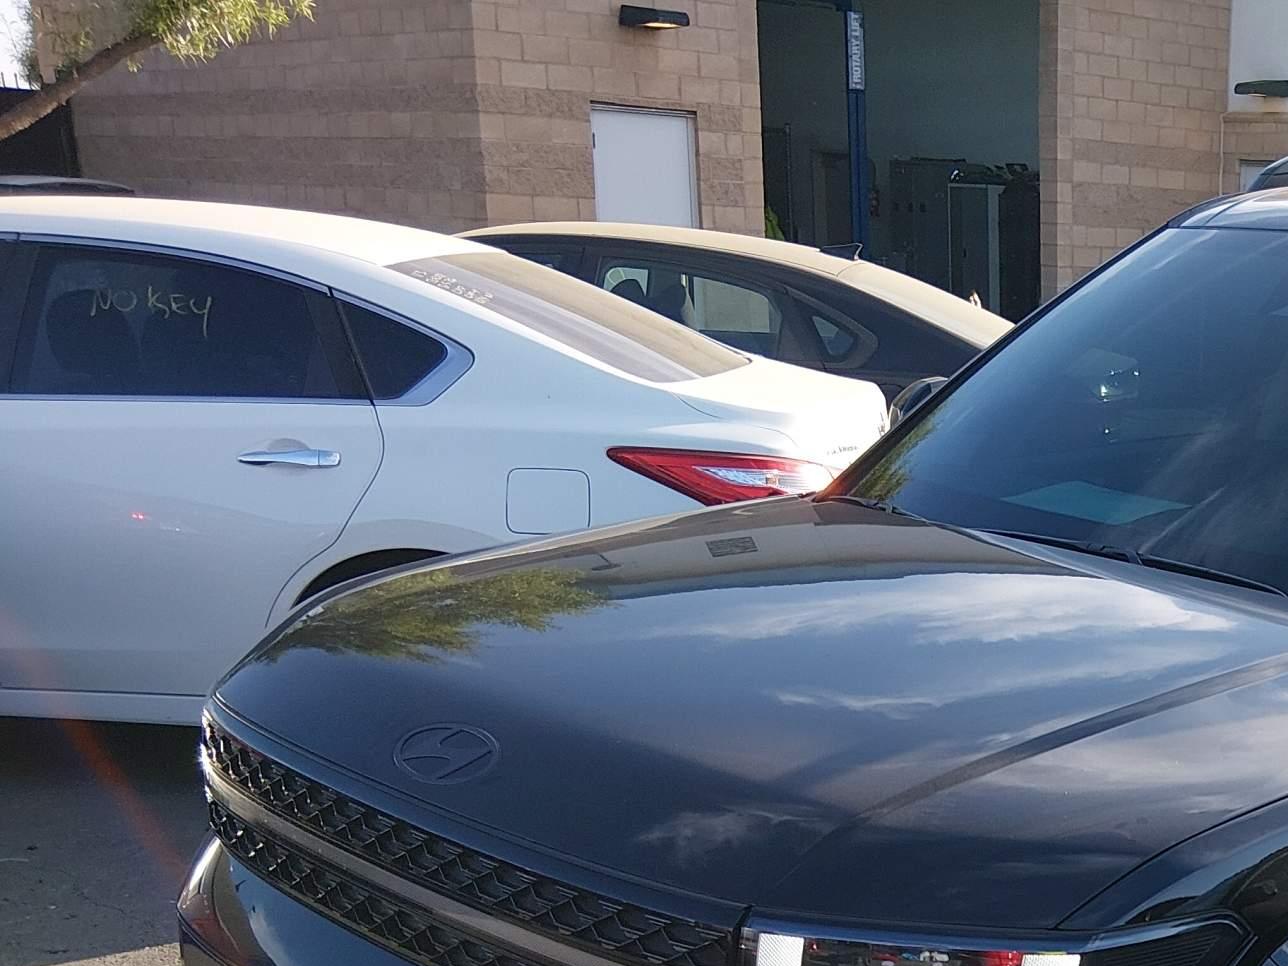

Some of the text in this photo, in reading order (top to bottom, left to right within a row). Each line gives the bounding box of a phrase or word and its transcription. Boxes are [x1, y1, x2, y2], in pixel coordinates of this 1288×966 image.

[851, 14, 862, 83] ROTARY LIFT
[90, 285, 213, 339] NO KEY
